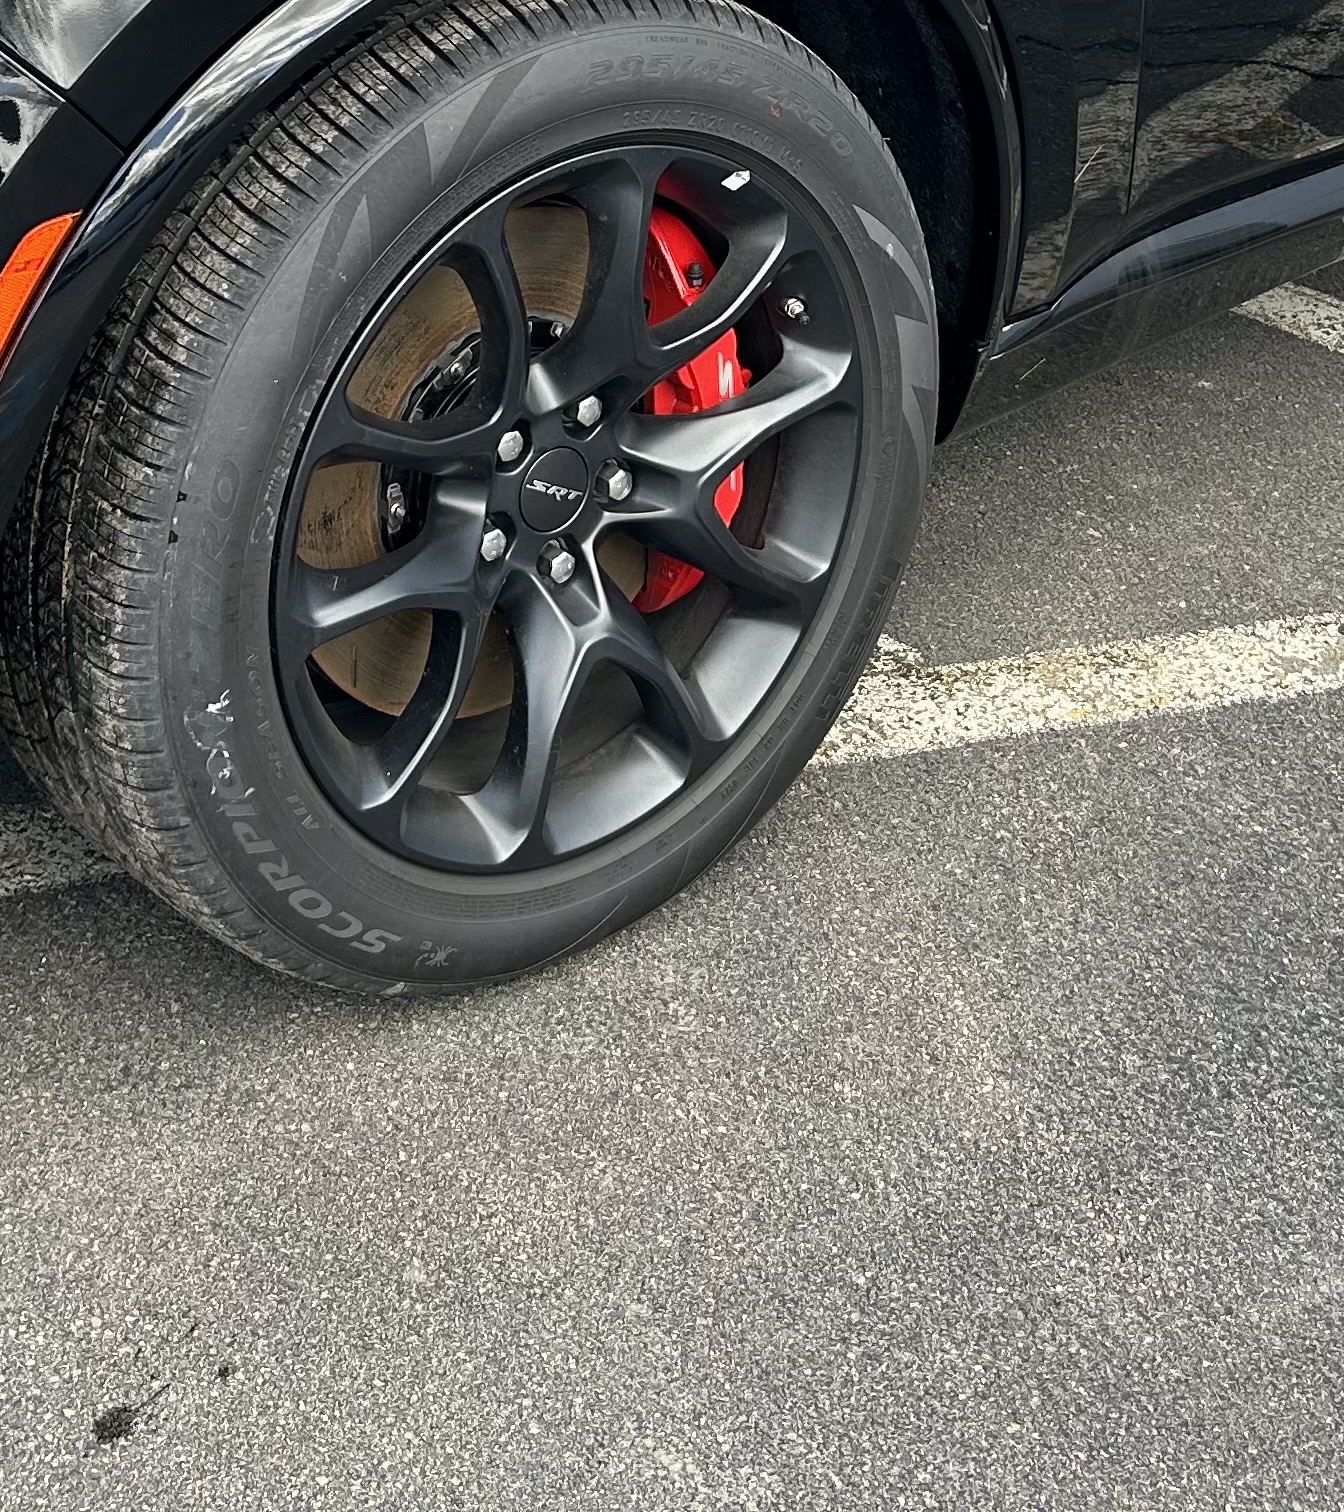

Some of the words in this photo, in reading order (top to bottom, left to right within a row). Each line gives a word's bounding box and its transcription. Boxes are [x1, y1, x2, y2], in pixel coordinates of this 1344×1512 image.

[584, 53, 749, 94] 295/45
[525, 479, 584, 502] SRT
[286, 792, 322, 832] ALL
